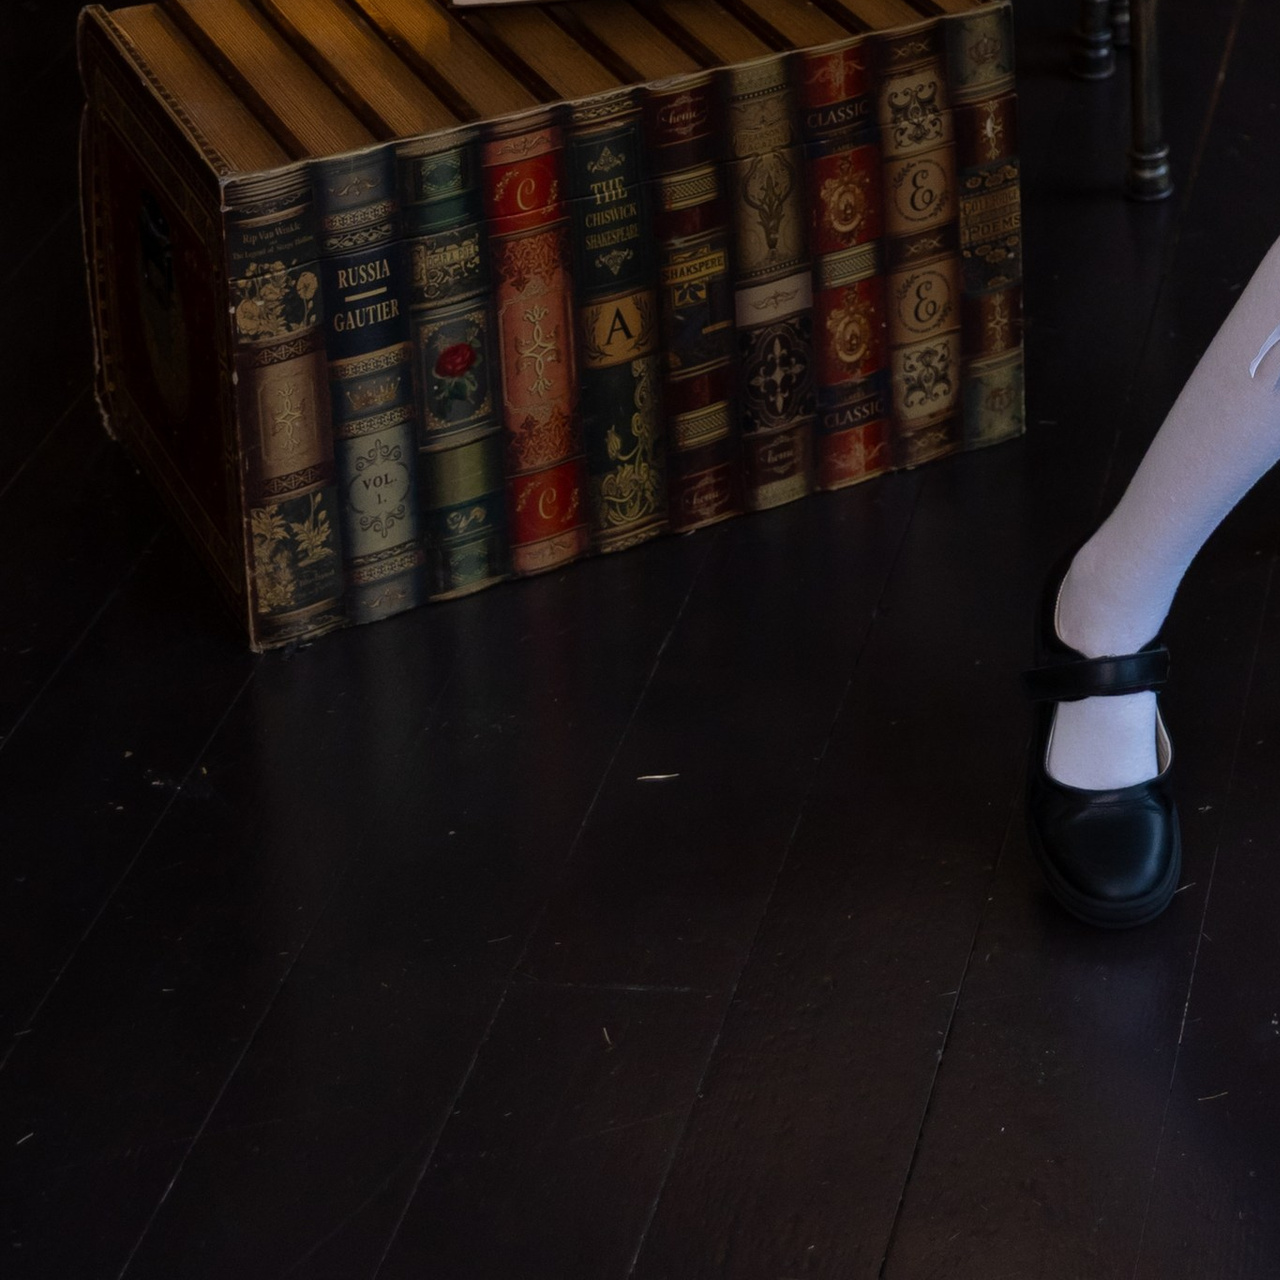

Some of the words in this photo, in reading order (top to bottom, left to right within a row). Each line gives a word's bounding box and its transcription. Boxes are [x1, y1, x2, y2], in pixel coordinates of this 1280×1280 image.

[806, 99, 871, 130] CLASSIC
[590, 176, 628, 206] THE
[584, 203, 638, 230] CHISWICK
[337, 258, 391, 289] RUSSIA
[661, 252, 725, 281] SHAKSPERE
[333, 298, 400, 333] GAUTIER
[606, 306, 635, 346] A
[823, 397, 886, 429] CLASSIC
